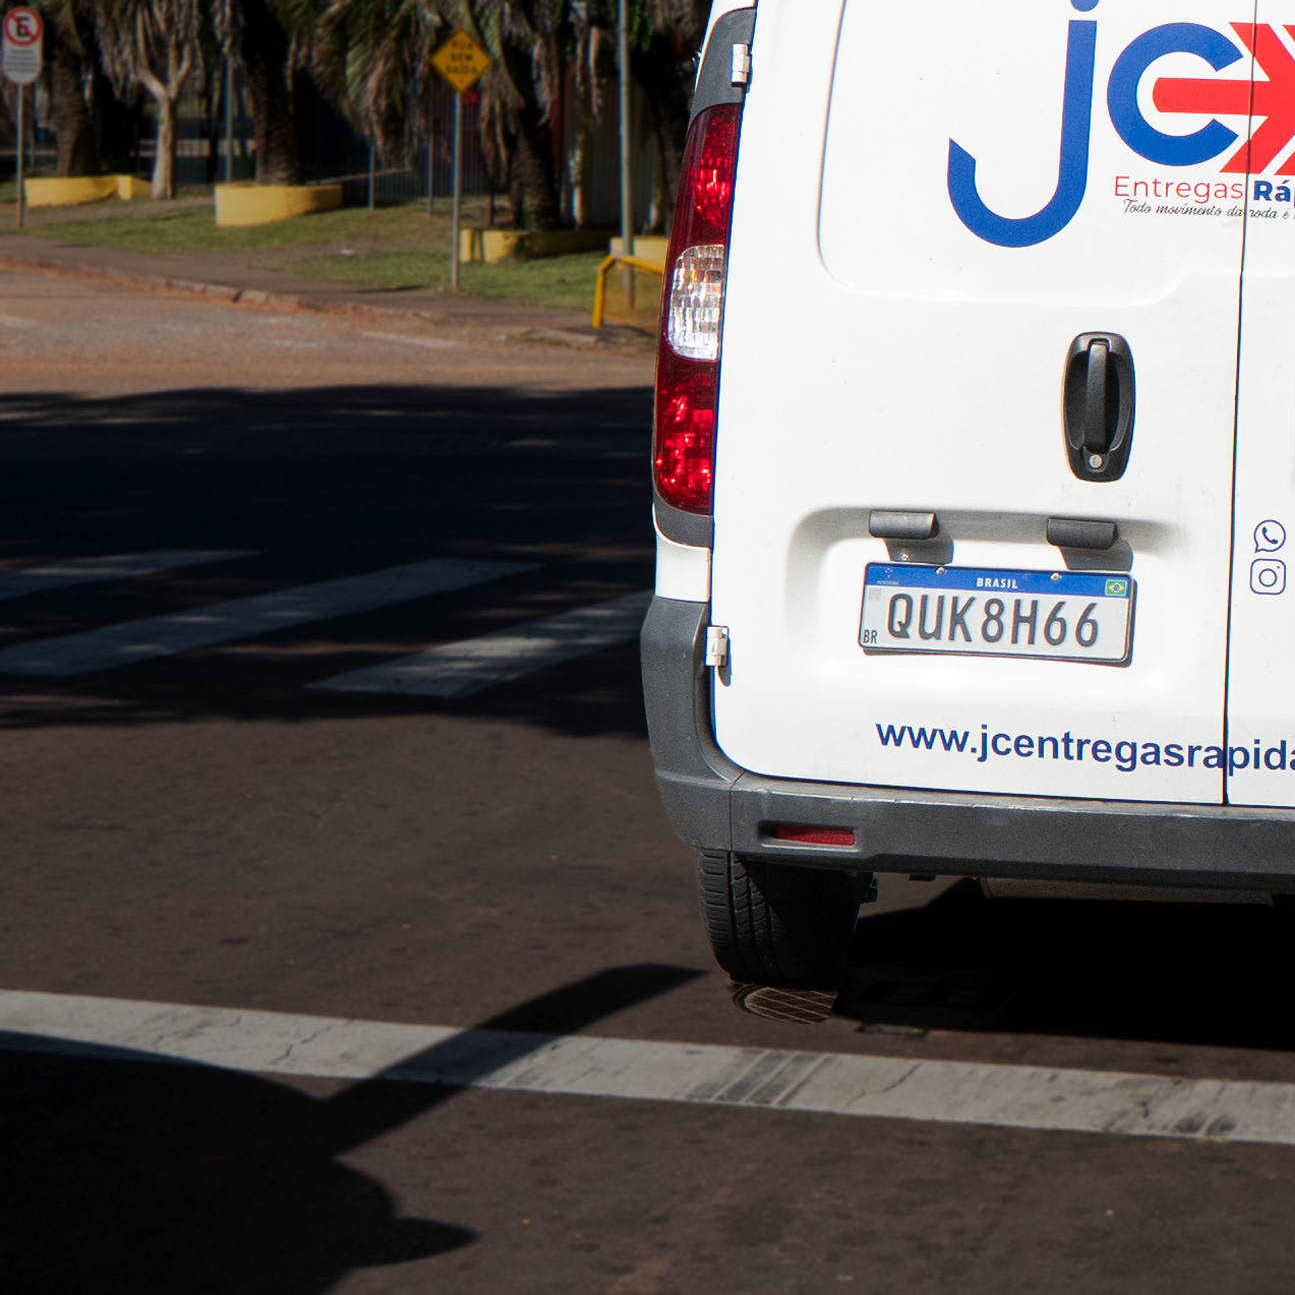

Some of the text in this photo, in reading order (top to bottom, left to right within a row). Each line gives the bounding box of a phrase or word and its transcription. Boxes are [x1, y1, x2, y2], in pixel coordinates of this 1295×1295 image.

[451, 52, 473, 62] SEM
[1114, 175, 1244, 205] Entregas
[1122, 198, 1152, 215] Todo
[1155, 203, 1222, 217] movimento
[976, 576, 1018, 589] BRASIL
[887, 592, 1099, 648] QUK8H66
[862, 629, 878, 645] BR
